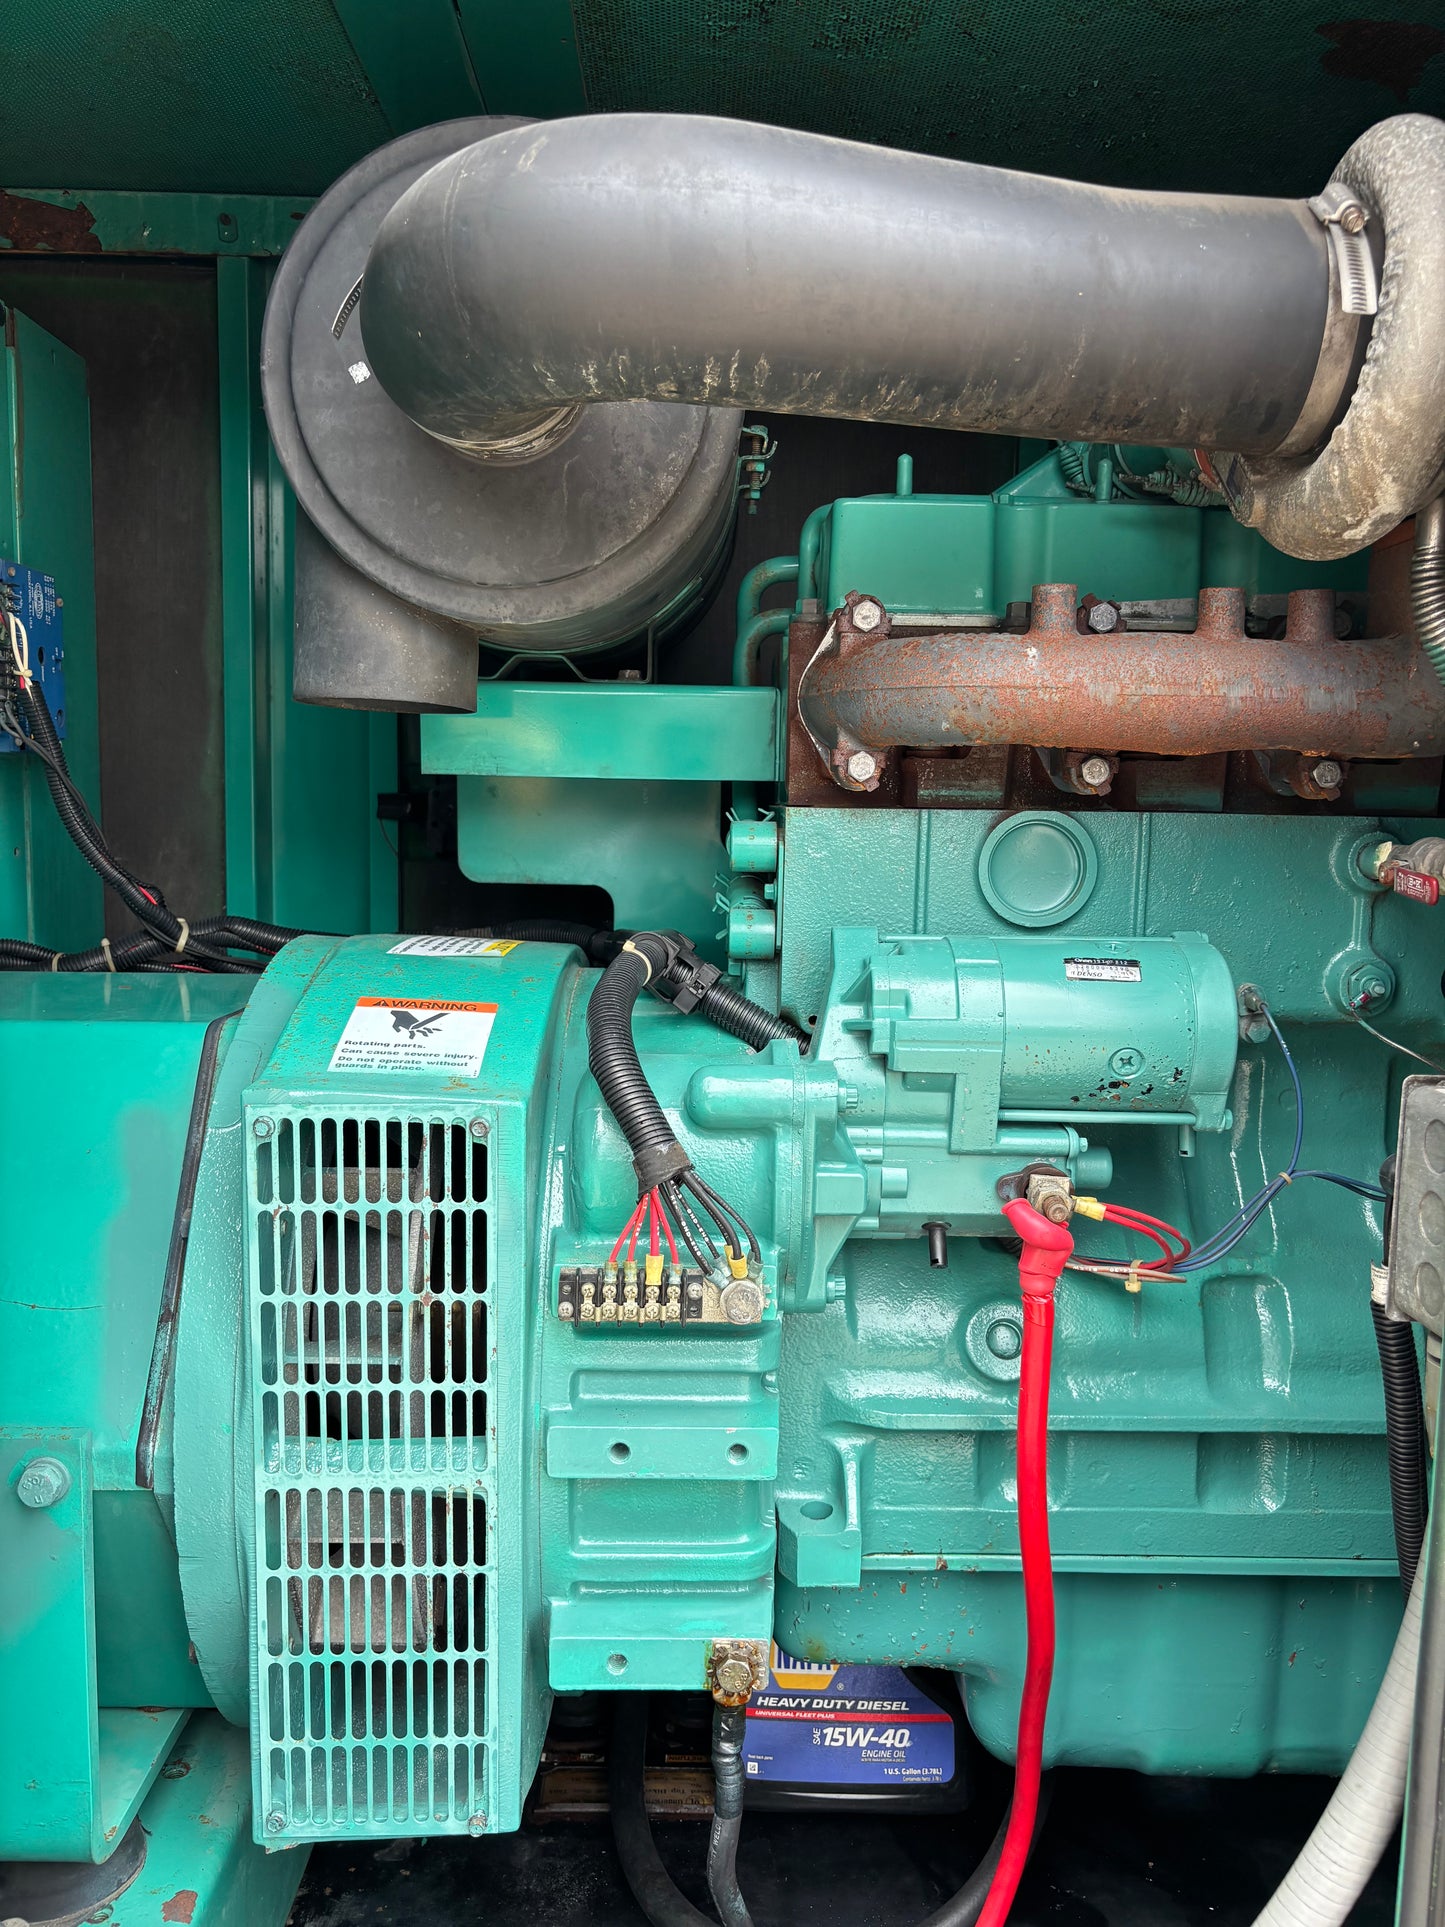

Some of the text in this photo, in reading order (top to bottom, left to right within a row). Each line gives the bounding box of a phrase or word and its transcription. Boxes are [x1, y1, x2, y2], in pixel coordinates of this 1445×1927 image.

[1076, 970, 1103, 978] DENSO
[391, 1000, 477, 1012] WARNING
[756, 1696, 910, 1711] HEAVY DUTY DIESEL
[813, 1727, 821, 1746] SAE
[822, 1726, 910, 1748] 15W-40
[861, 1749, 906, 1758] ENGINE OIL
